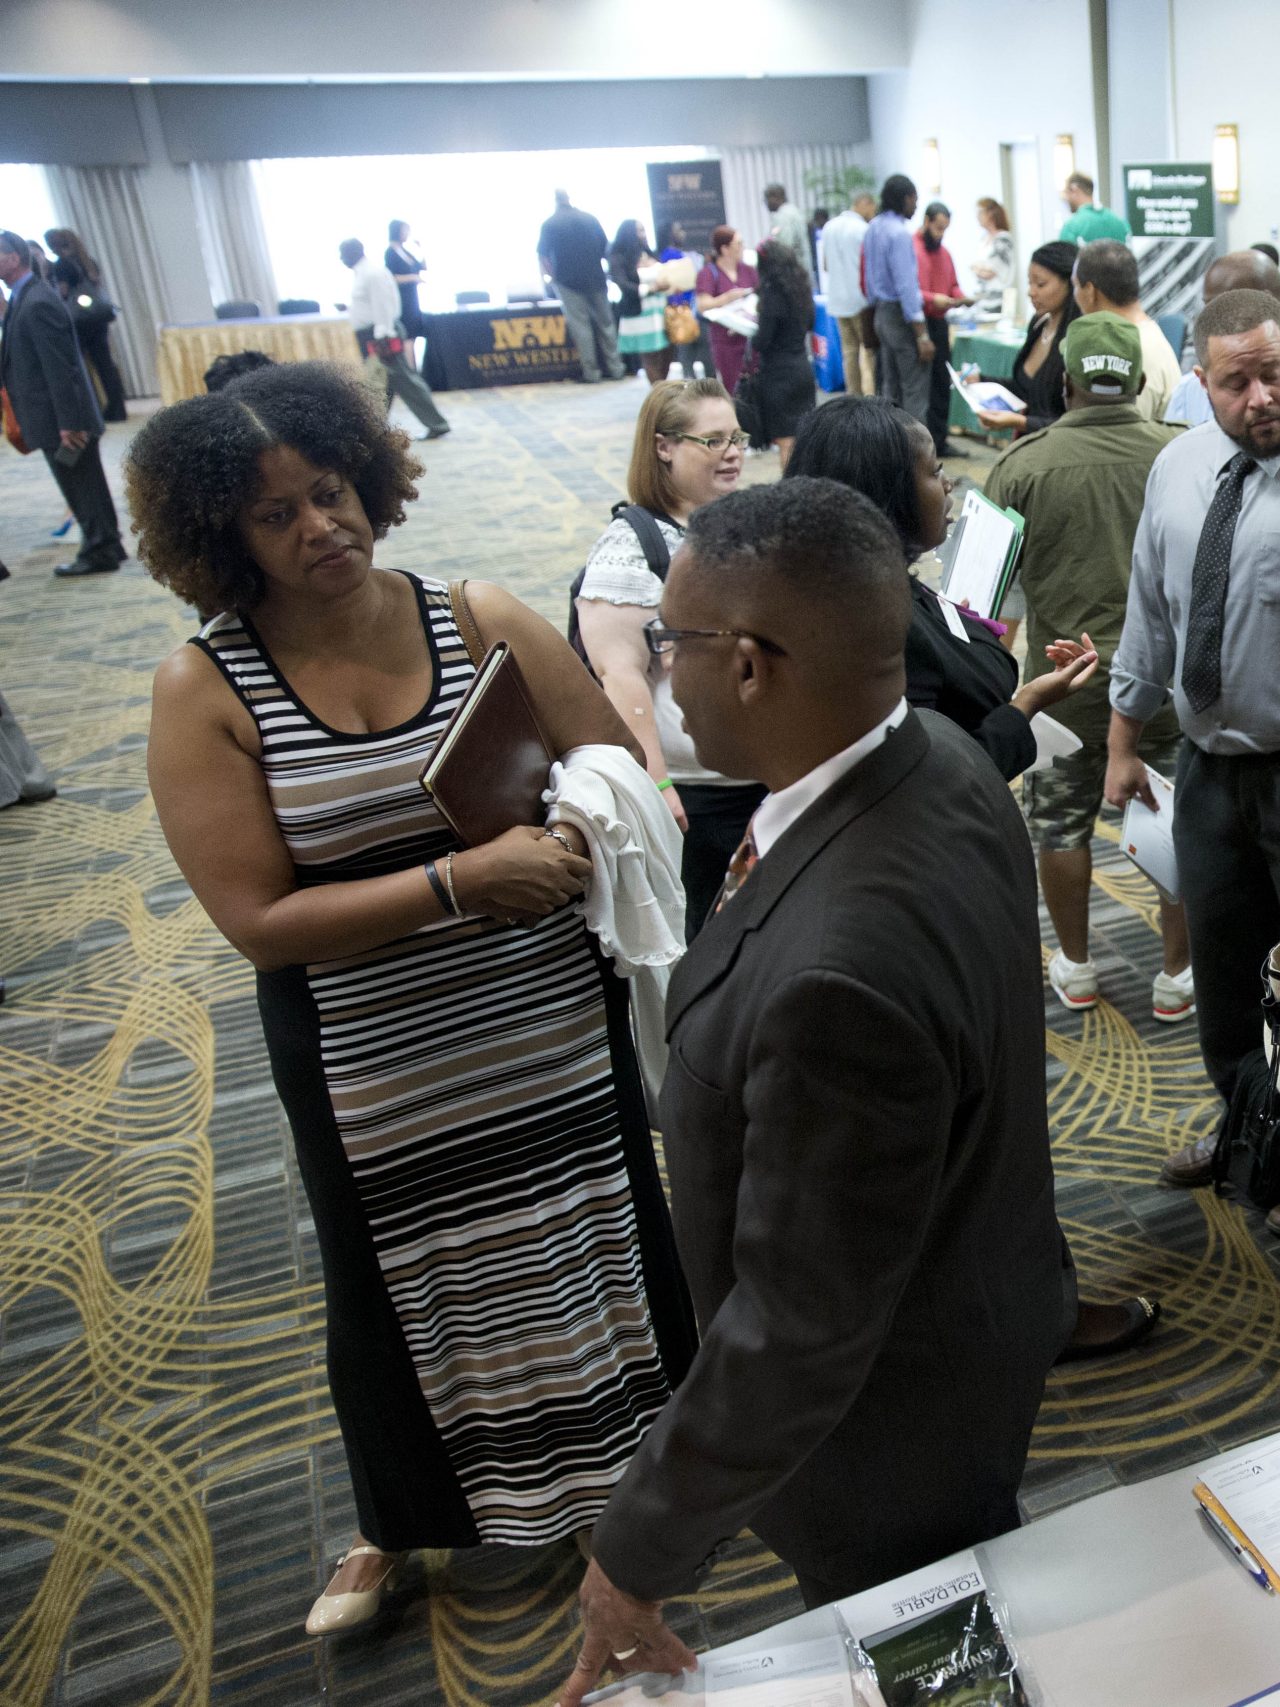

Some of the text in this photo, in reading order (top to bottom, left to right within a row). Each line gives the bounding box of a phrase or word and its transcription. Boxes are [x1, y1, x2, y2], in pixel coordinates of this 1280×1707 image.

[468, 352, 508, 369] NEW
[1081, 355, 1132, 376] NEW YORK
[891, 1571, 976, 1608] Metallic Water Bottle
[893, 1576, 980, 1617] FOLDABLE
[893, 1662, 928, 1684] career
